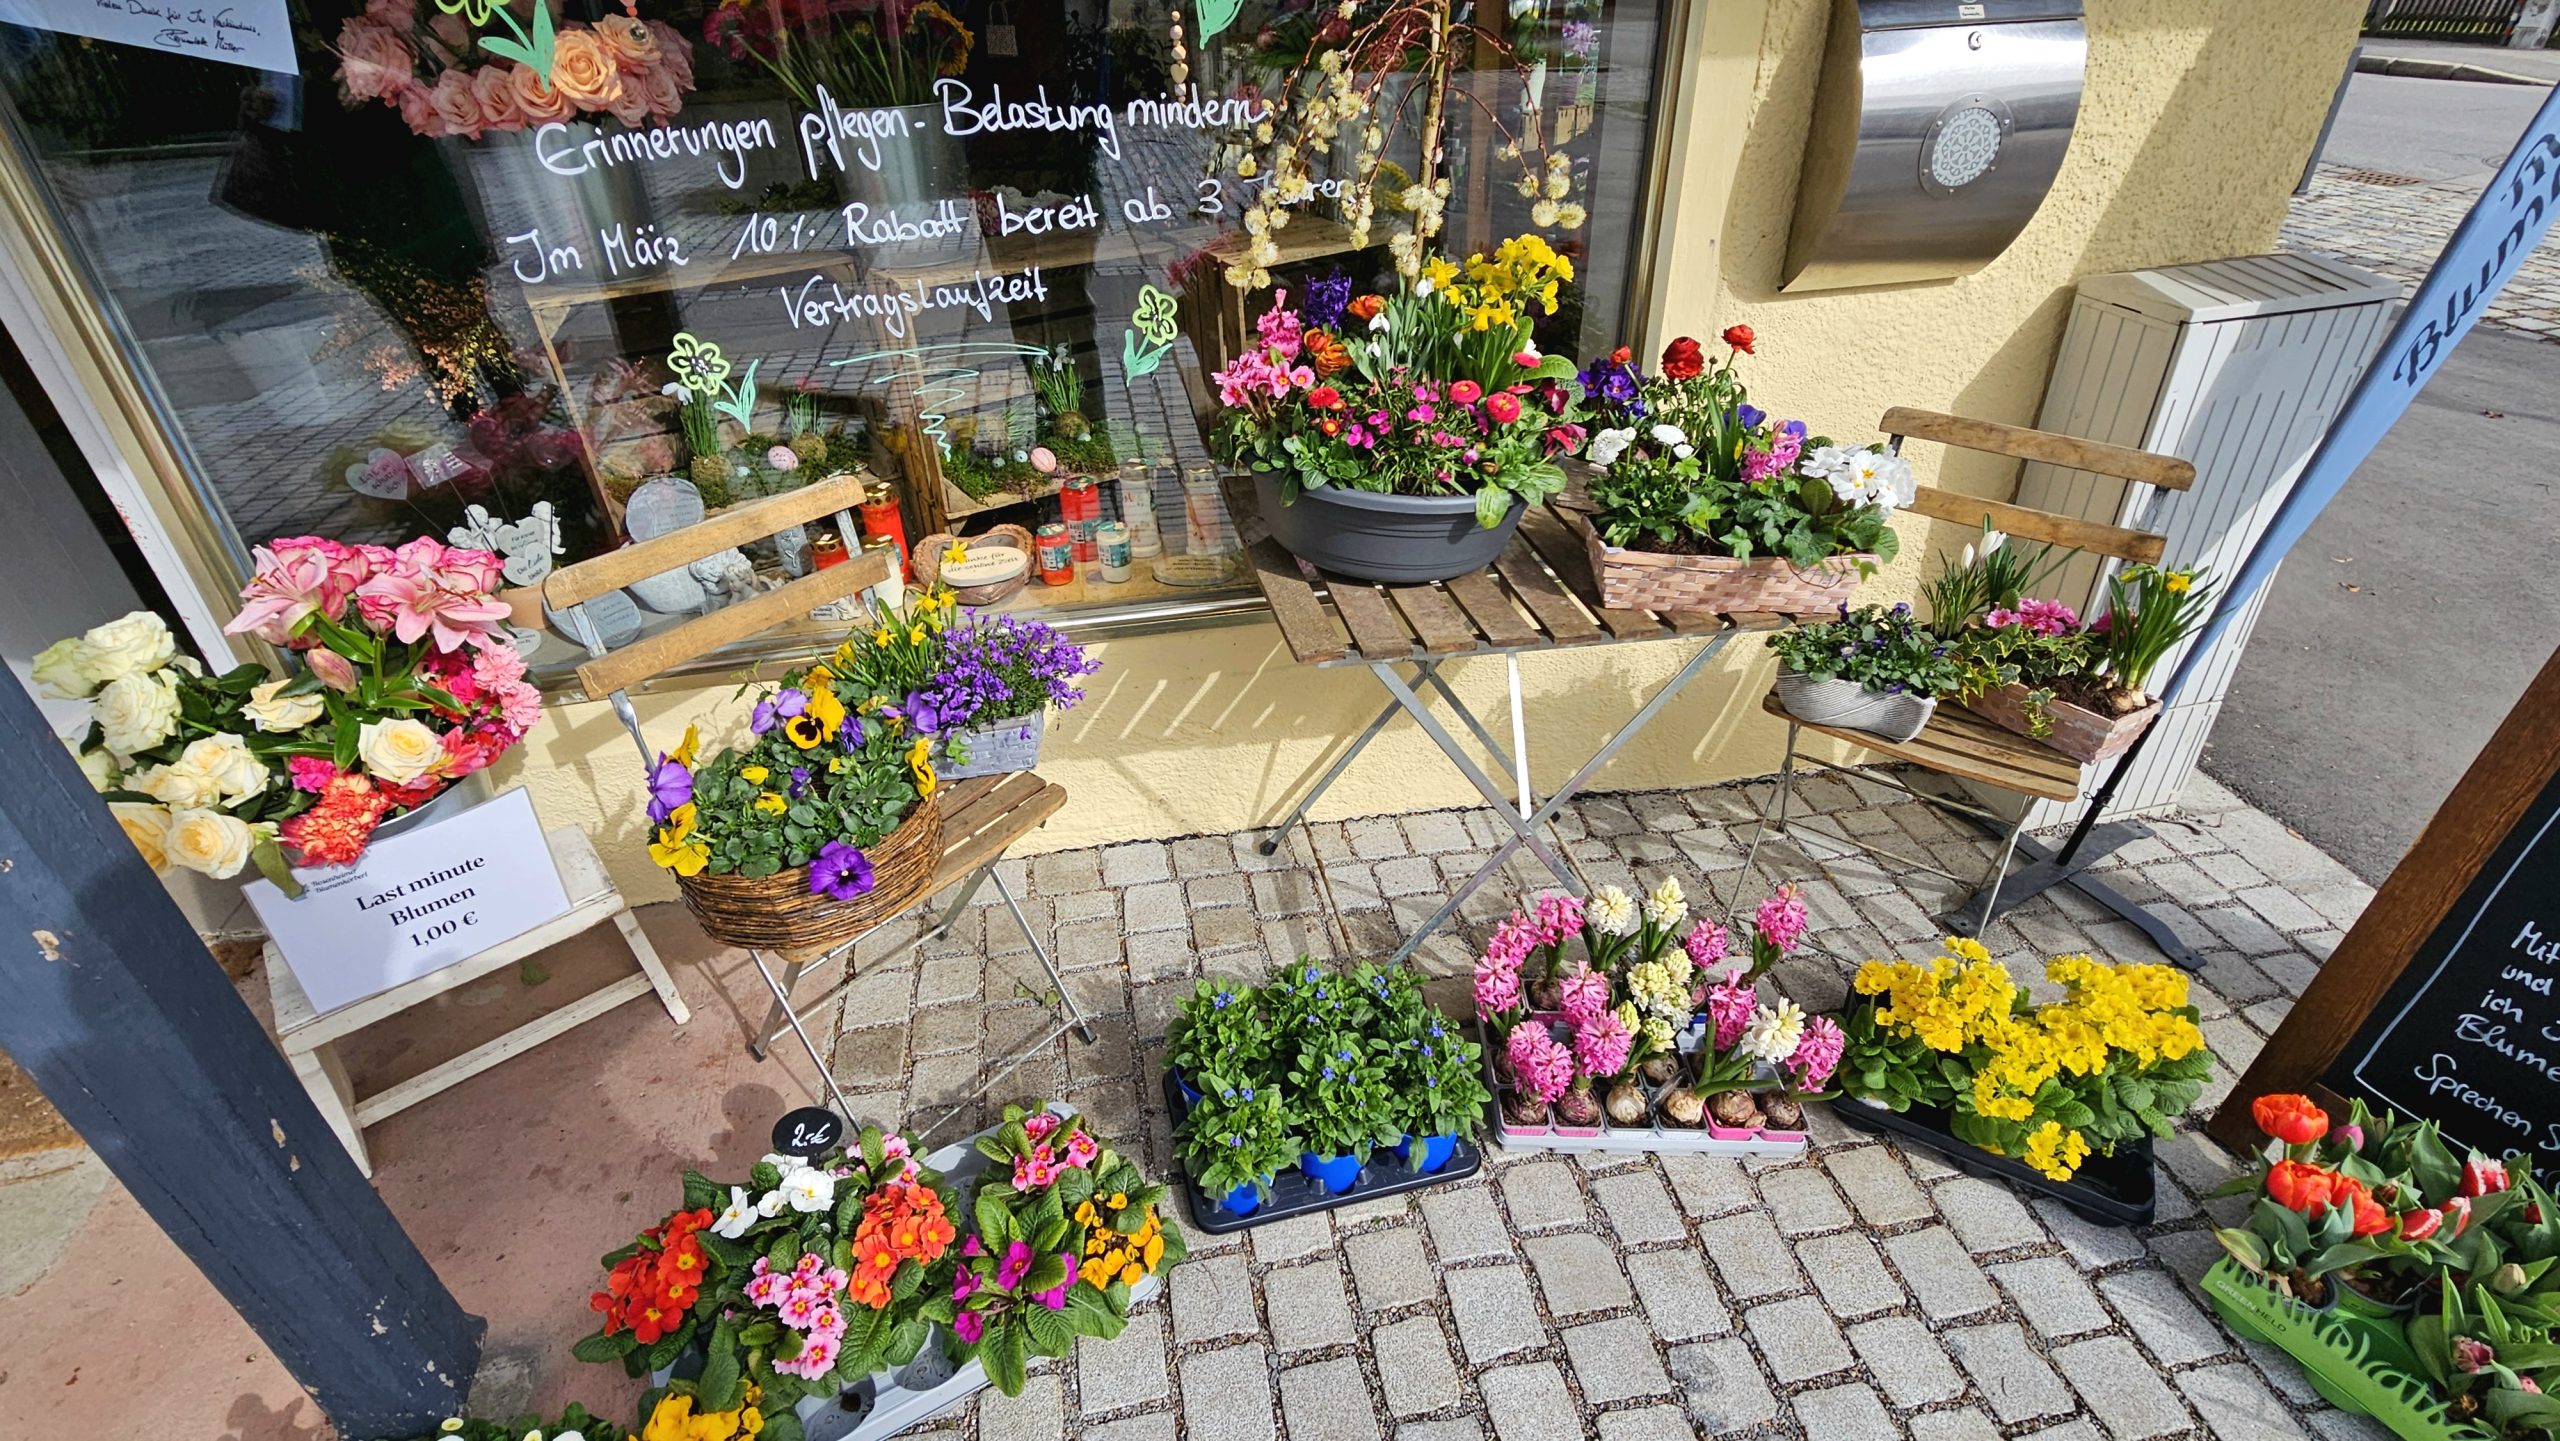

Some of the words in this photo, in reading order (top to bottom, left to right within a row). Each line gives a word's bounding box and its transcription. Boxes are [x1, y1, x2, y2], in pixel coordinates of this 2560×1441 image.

[535, 122, 776, 189] Erinnerungen
[801, 83, 909, 181] pflegen
[933, 78, 1120, 161] Belastung
[1128, 83, 1274, 129] mindern
[600, 222, 690, 276] März
[731, 212, 778, 260] 10
[842, 201, 970, 247] Rabatt
[996, 192, 1099, 237] bereit
[1123, 186, 1172, 223] ab
[1199, 178, 1224, 214] 3
[780, 266, 1048, 338] Vertragslaufzeit
[355, 884, 404, 911] Last
[408, 857, 486, 893] minute
[389, 887, 476, 927] Blumen
[410, 919, 457, 947] 1,00
[463, 910, 479, 927] €
[2511, 920, 2560, 964] Mit
[2501, 964, 2554, 996] und
[2480, 989, 2523, 1024] ich
[2414, 1053, 2532, 1137] Sprechen
